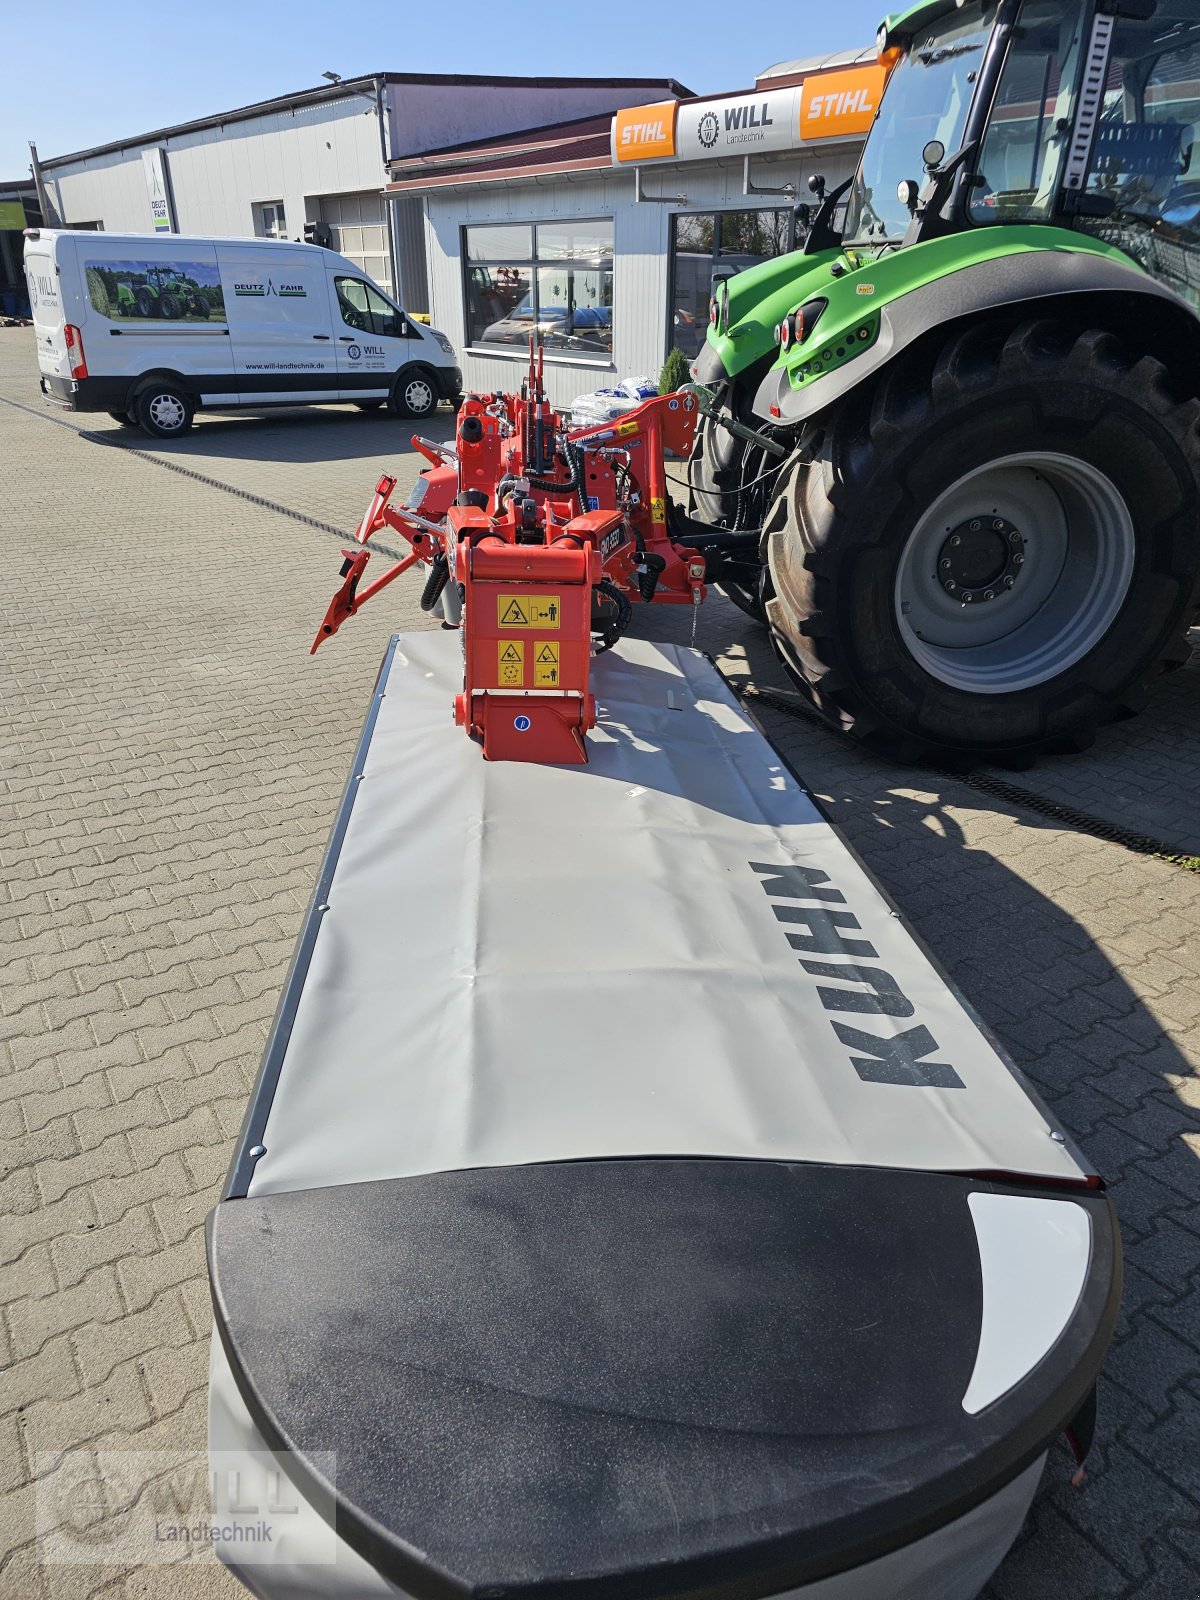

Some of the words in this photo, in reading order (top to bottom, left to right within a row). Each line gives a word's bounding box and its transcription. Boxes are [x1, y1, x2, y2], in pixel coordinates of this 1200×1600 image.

[807, 88, 873, 120] STIHL
[724, 102, 773, 132] WILL
[621, 120, 667, 145] STIHL
[726, 130, 765, 145] Landtechnik
[151, 200, 166, 209] DEUTZ
[154, 209, 167, 218] FAHR
[37, 276, 57, 296] WILL
[363, 346, 385, 355] WILL
[245, 362, 325, 370] www.will-landtechnik.de
[747, 861, 967, 1089] KUHN
